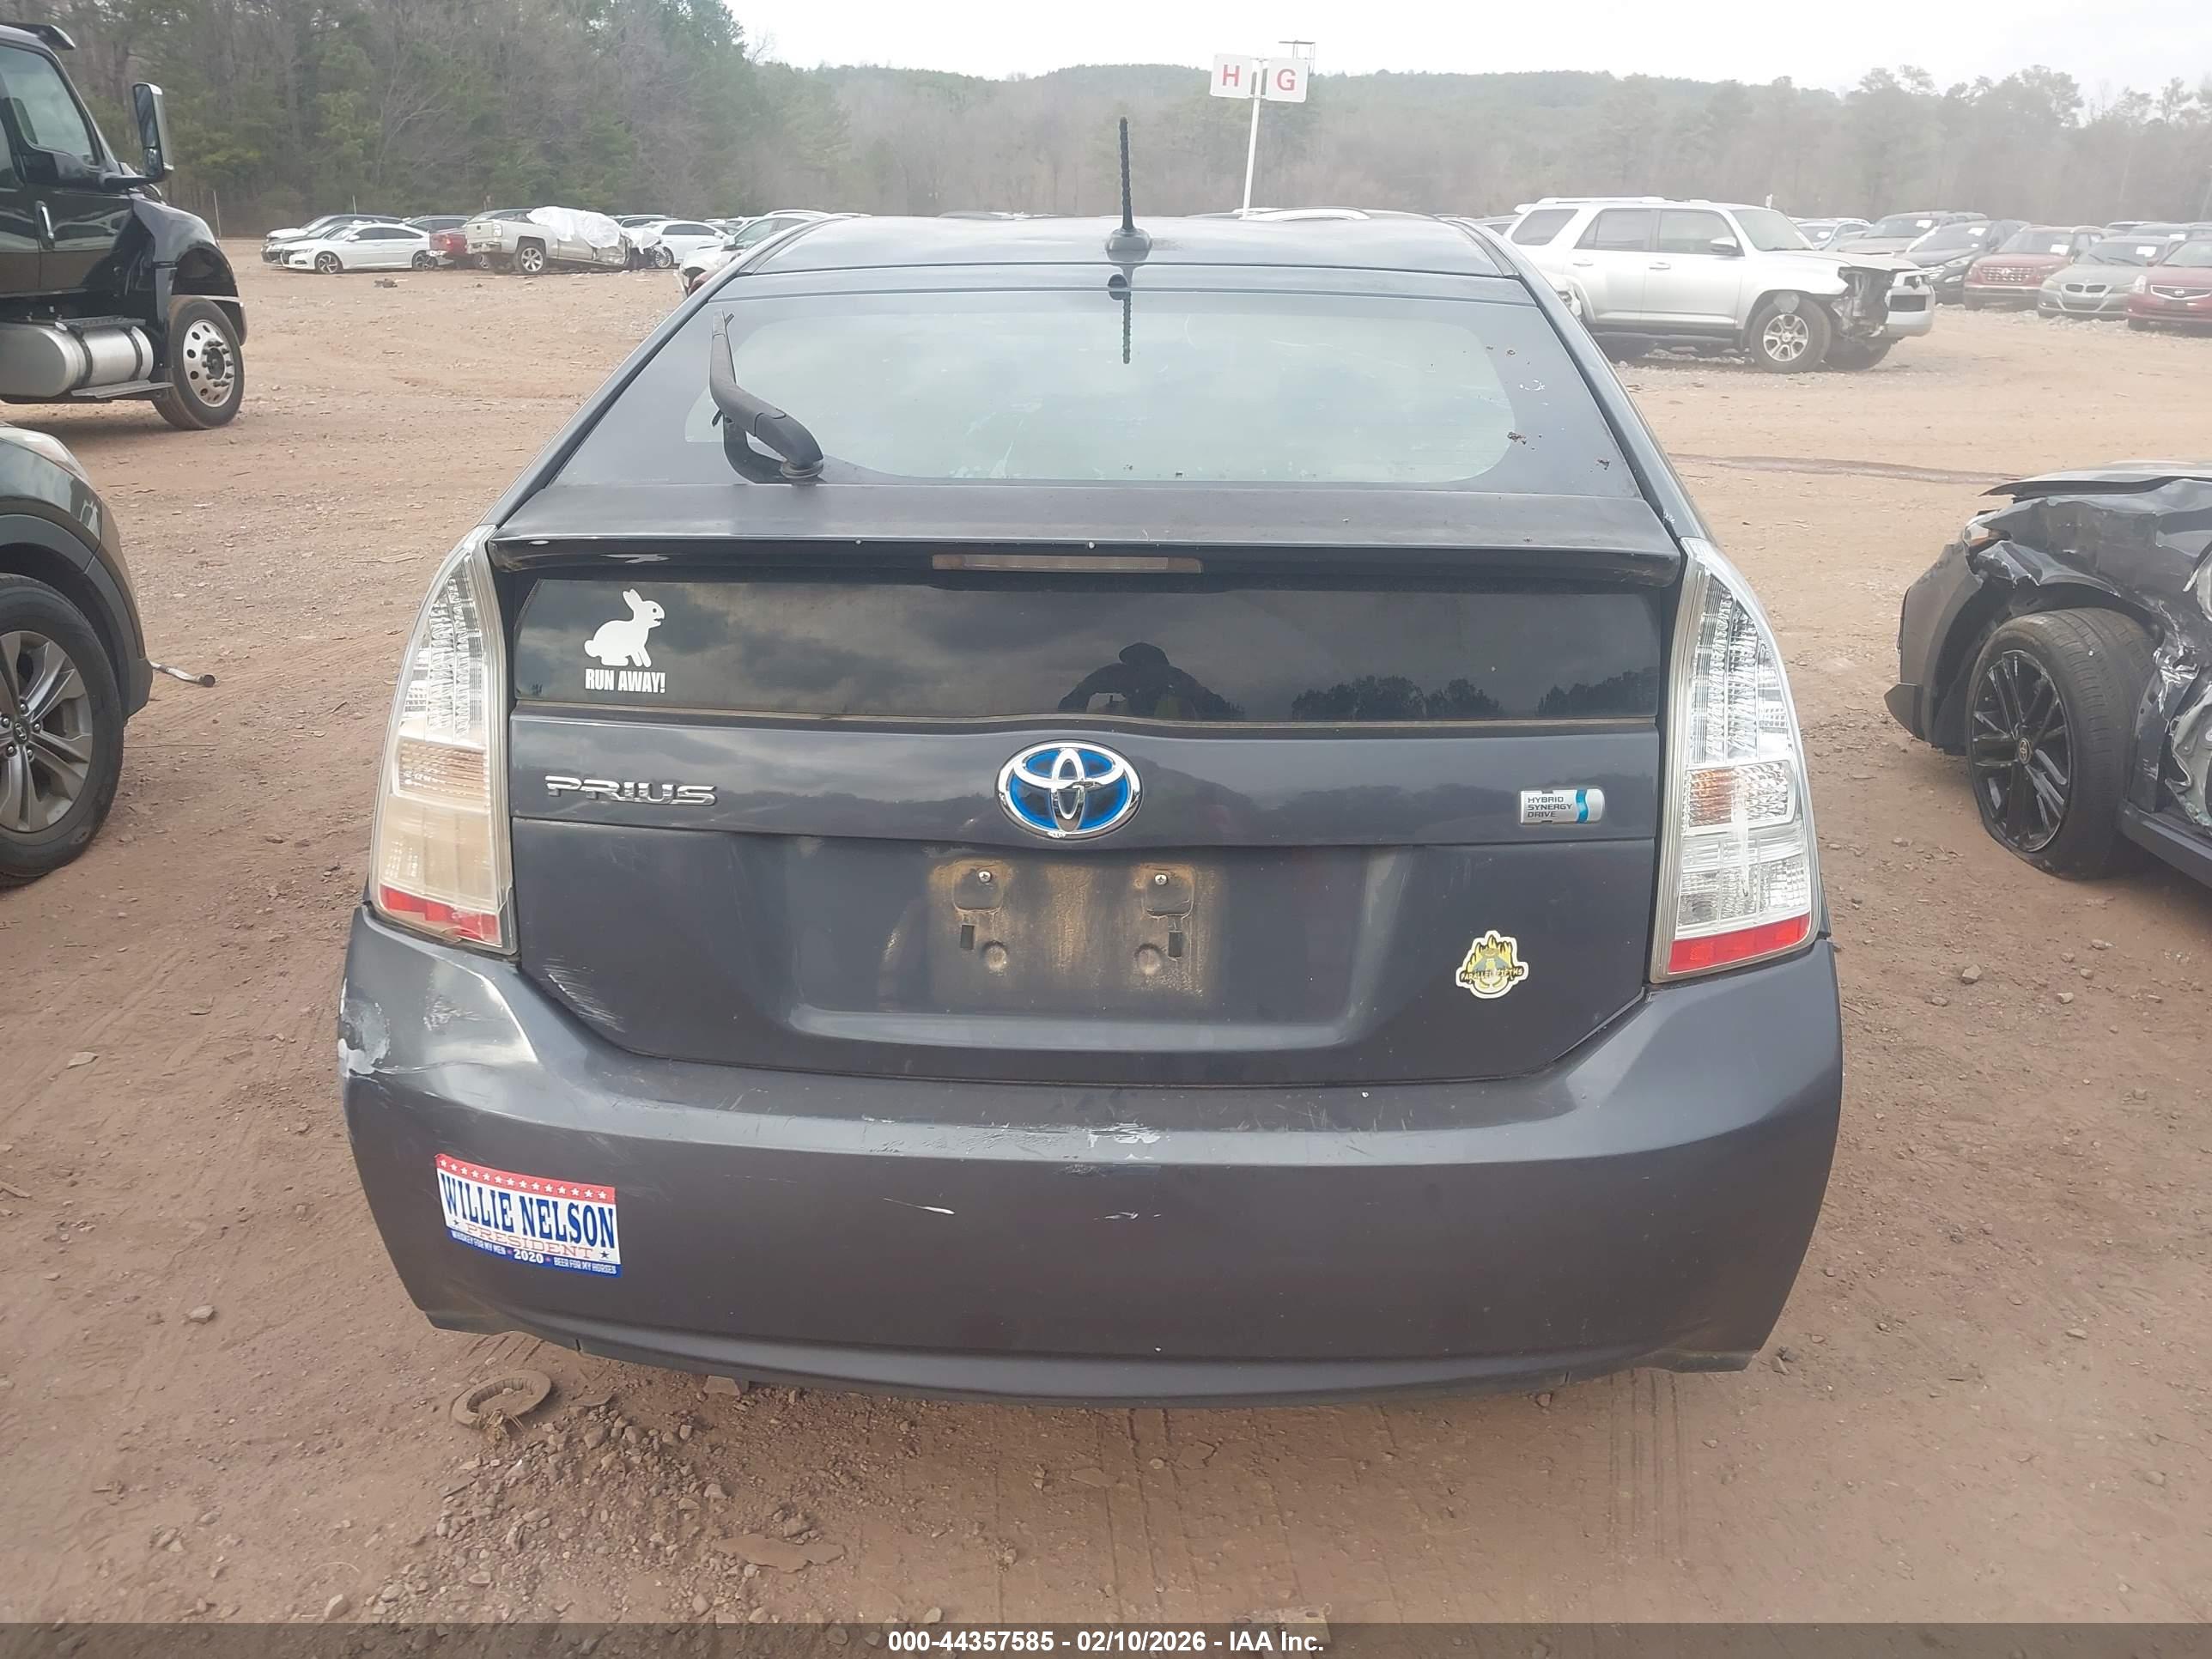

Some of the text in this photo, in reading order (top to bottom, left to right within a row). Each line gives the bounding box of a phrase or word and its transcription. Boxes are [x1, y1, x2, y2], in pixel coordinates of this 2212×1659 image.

[1223, 64, 1240, 87] H
[1277, 68, 1296, 91] G
[585, 668, 665, 694] RUN AWAY!
[544, 775, 717, 806] PRIUS
[441, 1173, 616, 1249] WILLIE NELSON
[465, 1222, 593, 1260] PRESIDENT
[514, 1249, 544, 1264] 2020
